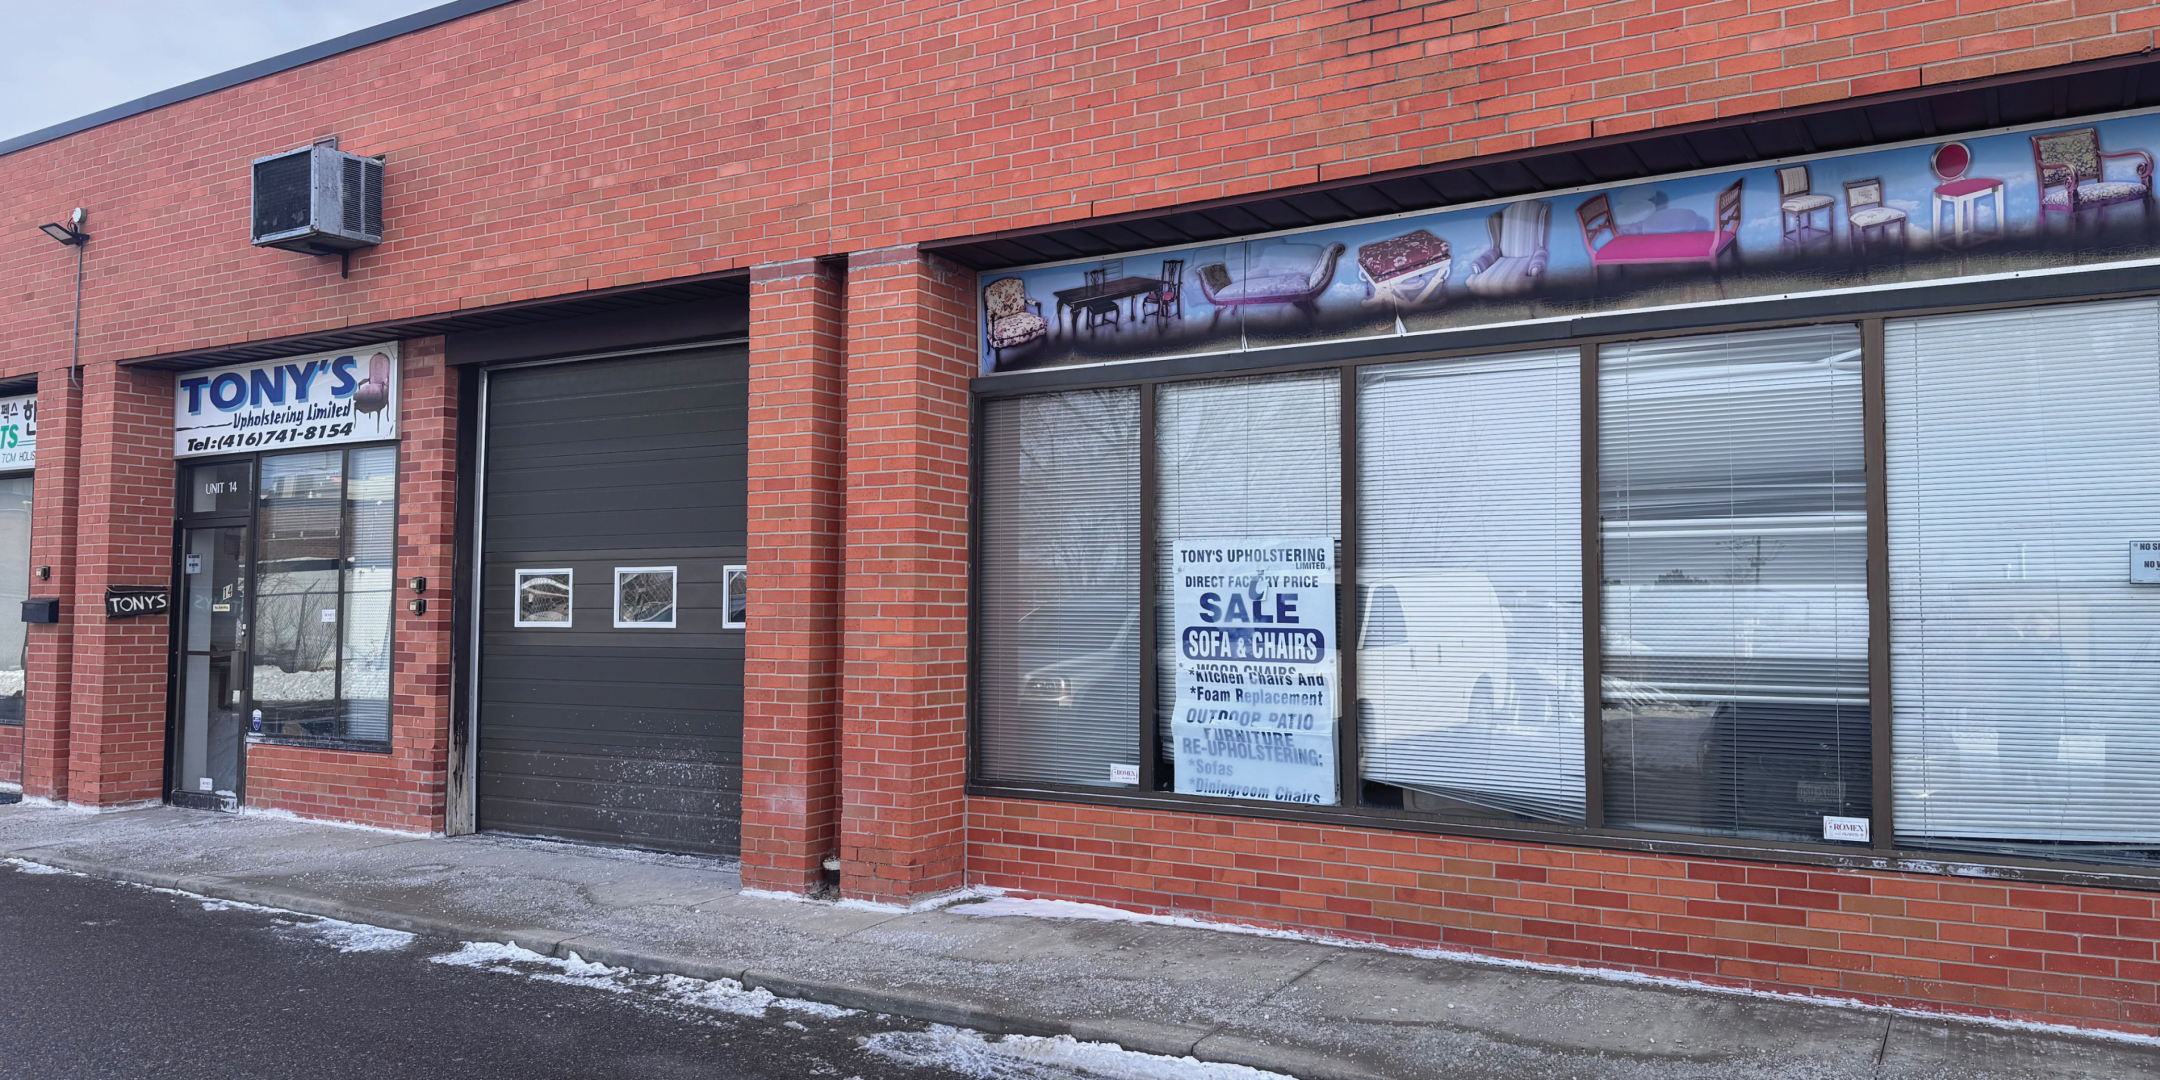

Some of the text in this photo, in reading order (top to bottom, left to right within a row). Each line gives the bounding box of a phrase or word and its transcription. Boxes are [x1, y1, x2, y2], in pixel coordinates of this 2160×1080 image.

[180, 355, 358, 416] TONY'S
[233, 398, 351, 431] Upholstering Limited
[205, 481, 238, 495] UNIT 14
[1181, 548, 1325, 563] TONY'S UPHOLSTERING
[2140, 543, 2151, 551] NO
[2144, 560, 2155, 568] NO
[1185, 575, 1225, 588] DIRECT
[1283, 575, 1319, 588] PRICE
[224, 585, 232, 599] 14
[1199, 592, 1300, 624] SALE
[1188, 630, 1318, 661] SOFA & CHAIRS
[1249, 671, 1293, 686] Chairs
[1298, 672, 1325, 686] And
[1235, 687, 1323, 707] Replacement
[1268, 712, 1314, 730] PATIO
[1203, 727, 1295, 747] FURNITURE
[1182, 737, 1324, 767] RE-UPHOLSTERING:
[1275, 785, 1321, 804] Chairs
[1833, 823, 1864, 832] ROMEX
